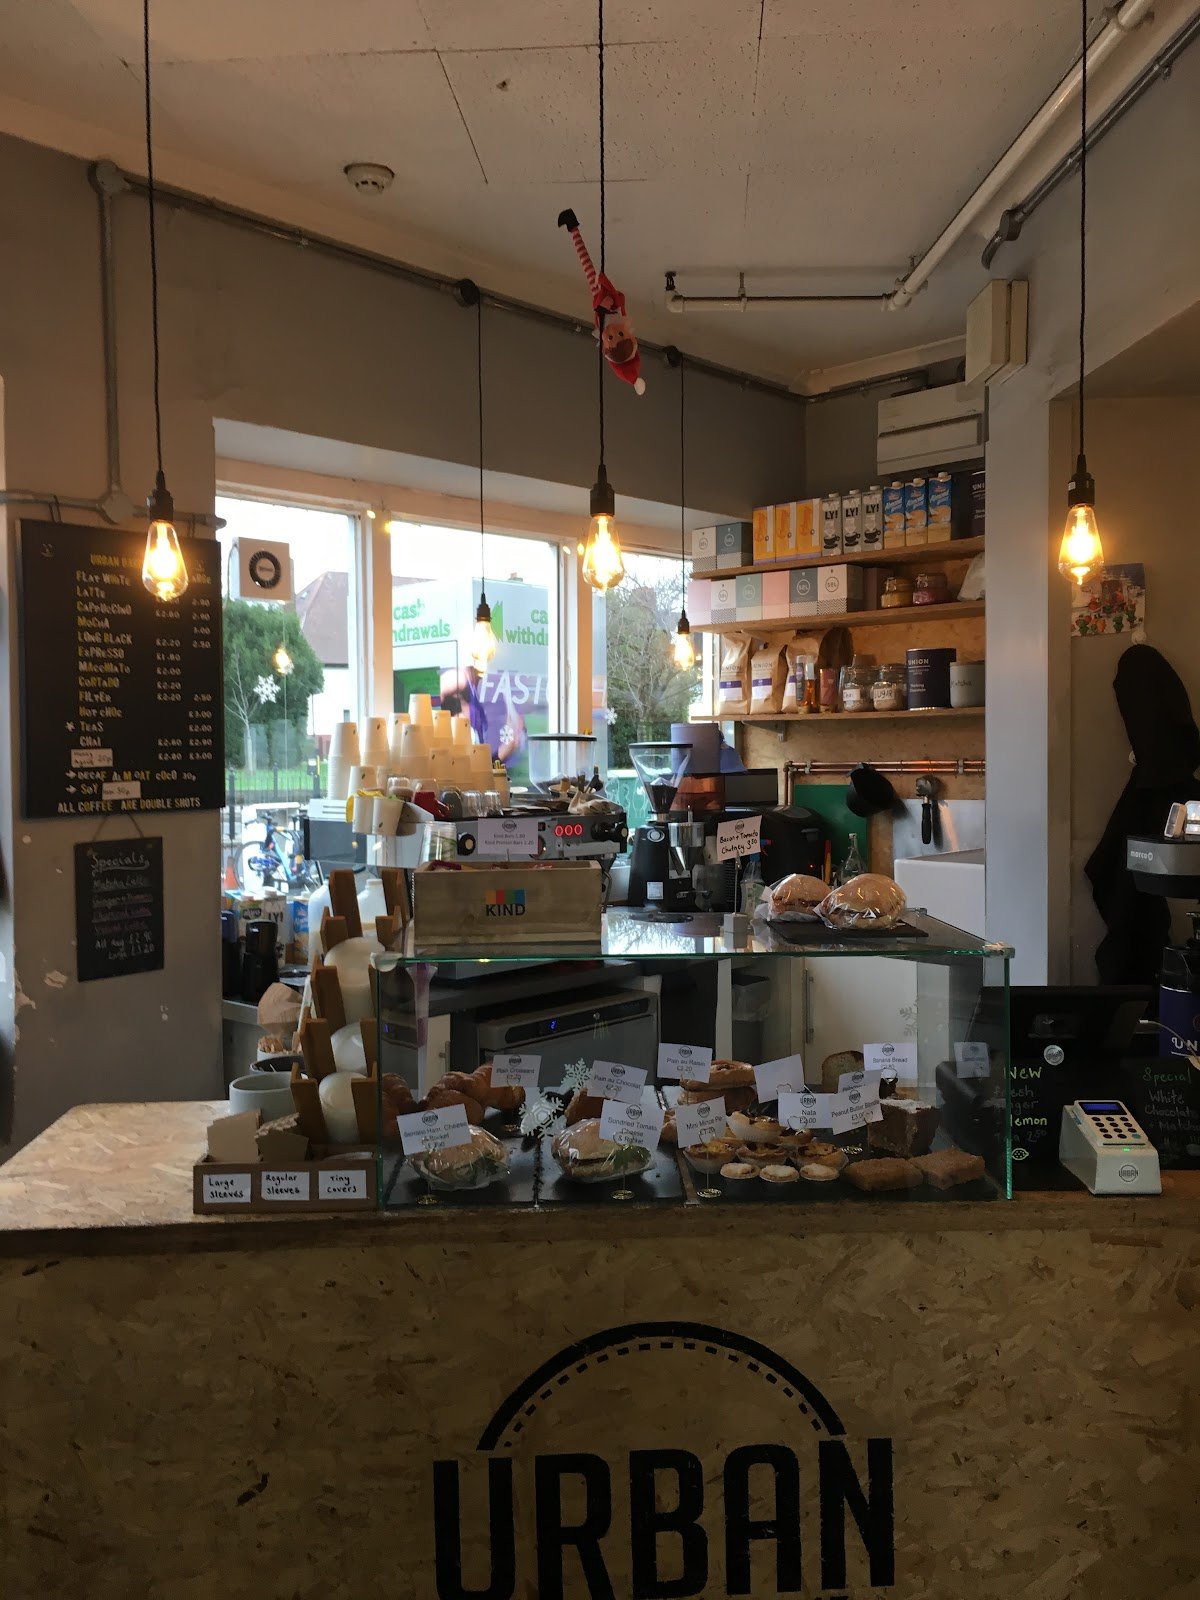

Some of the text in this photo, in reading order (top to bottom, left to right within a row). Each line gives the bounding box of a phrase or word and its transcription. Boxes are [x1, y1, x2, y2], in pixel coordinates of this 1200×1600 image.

[846, 507, 858, 517] LY!
[866, 504, 879, 514] LY!
[825, 510, 838, 520] LY!
[57, 796, 201, 814] ALL COFFEE ARE DOUBLE SHOTS
[486, 904, 525, 917] KIND
[209, 1176, 235, 1190] Large
[265, 1173, 298, 1187] Regular
[267, 1185, 300, 1195] sleeves
[327, 1184, 357, 1194] covers
[209, 1190, 244, 1199] sleeves
[434, 1438, 894, 1600] URBAN
